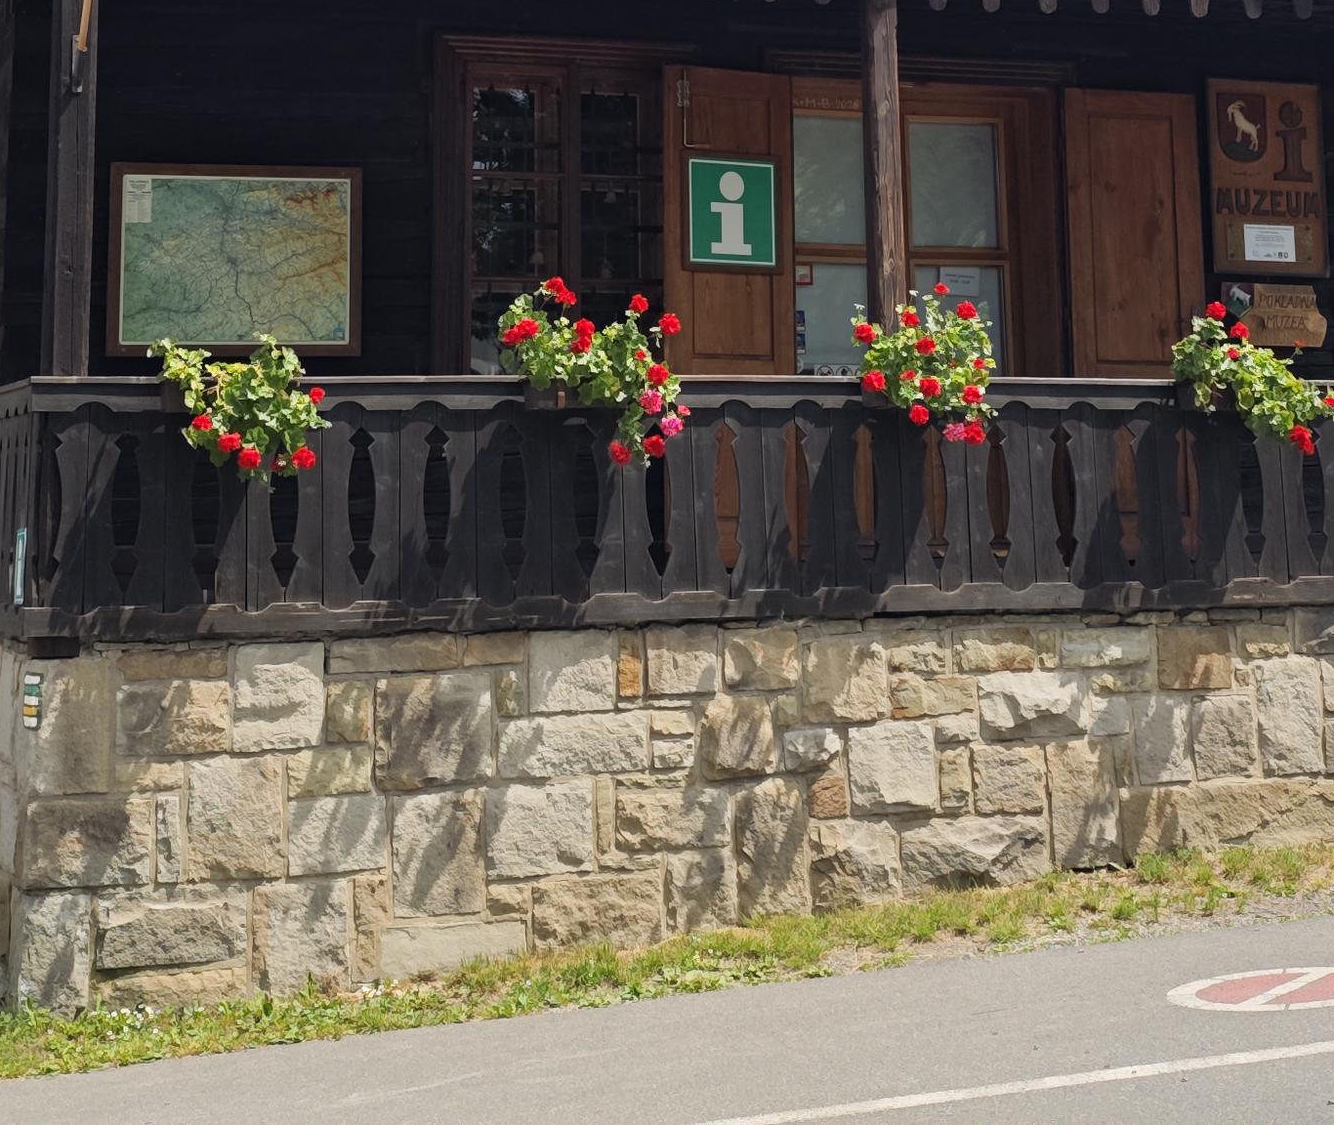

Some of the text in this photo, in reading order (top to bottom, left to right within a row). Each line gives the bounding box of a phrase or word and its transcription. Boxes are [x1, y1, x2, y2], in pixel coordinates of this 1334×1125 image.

[710, 171, 752, 255] i
[1216, 187, 1320, 218] MUZEUM
[1258, 293, 1315, 309] POKLADNA
[1266, 314, 1307, 330] MUZEA
